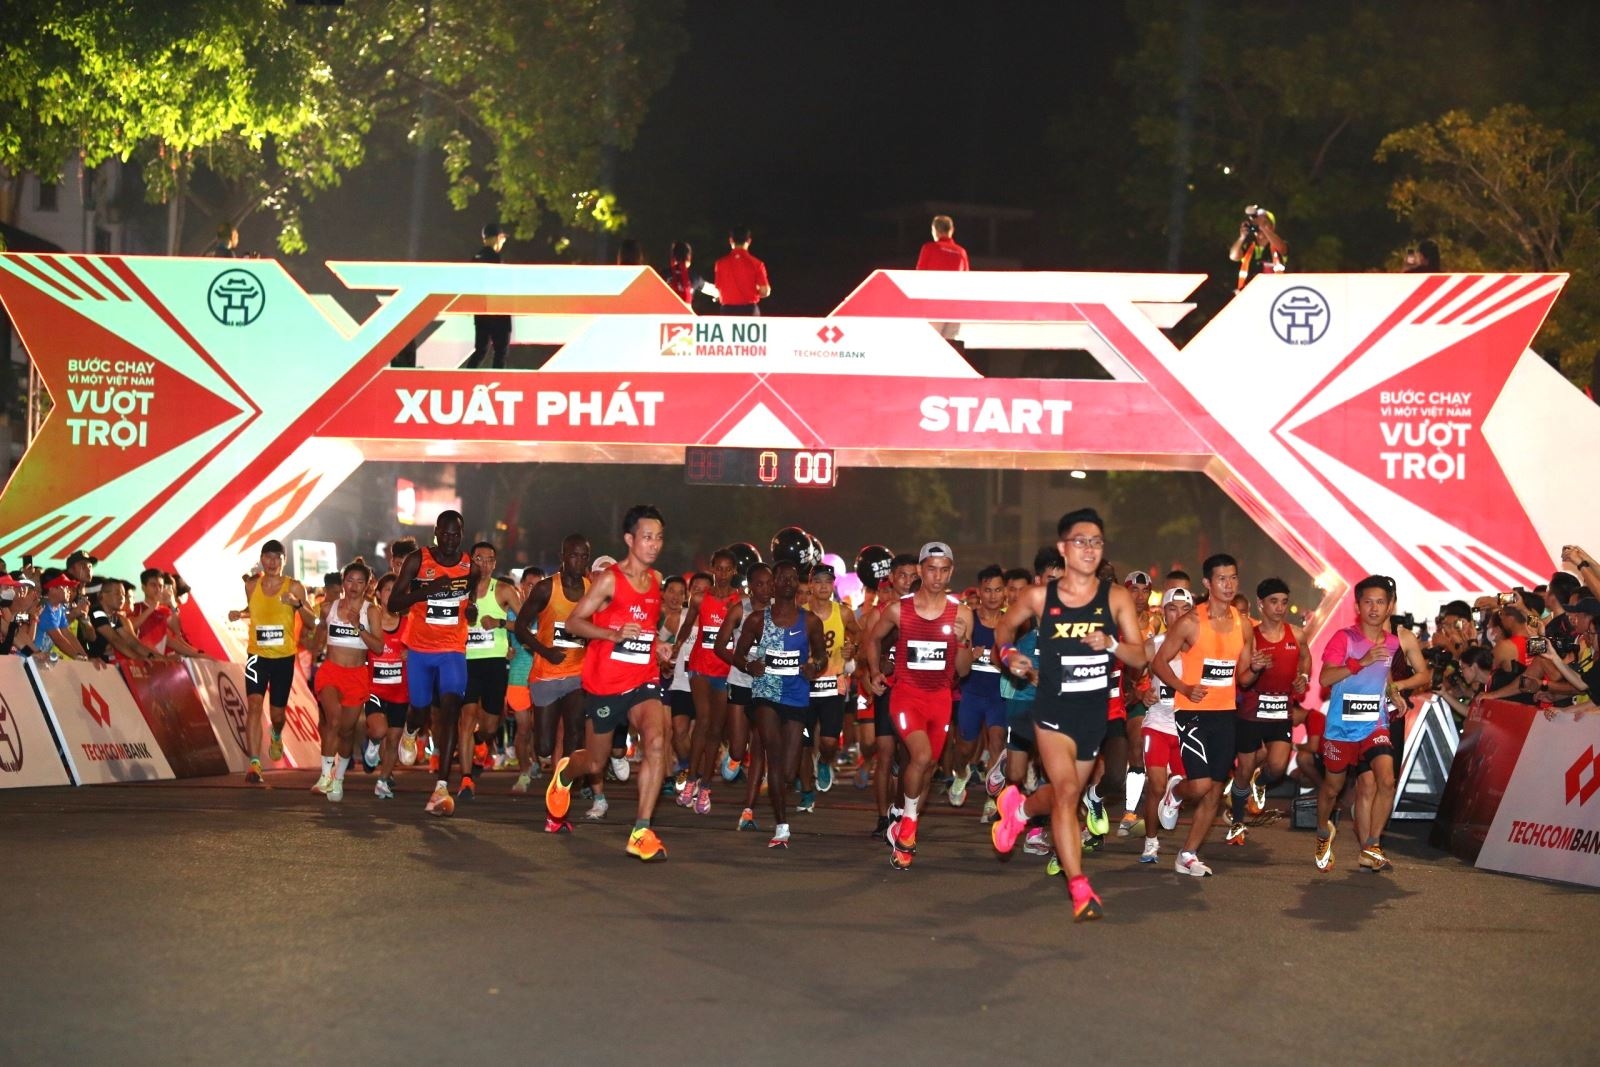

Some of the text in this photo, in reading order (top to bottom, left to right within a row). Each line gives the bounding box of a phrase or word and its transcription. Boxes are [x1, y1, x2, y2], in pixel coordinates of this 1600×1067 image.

[696, 323, 767, 343] HA NOI
[696, 345, 767, 356] MARATHON
[794, 349, 866, 359] TECHCOMBANK
[68, 357, 155, 376] BƯỚC CHẠY
[68, 373, 155, 387] VÌ MỘT VIỆT NAM
[67, 387, 155, 418] VƯỢT
[394, 381, 665, 426] XUẤT PHÁT
[1380, 388, 1471, 407] BƯỚC CHẠY
[919, 395, 1072, 436] START
[1380, 405, 1472, 418] VÌ MỘT VIỆT NAM
[1379, 419, 1472, 450] VƯỢT
[427, 607, 434, 615] A
[554, 629, 561, 637] A
[623, 641, 651, 651] 40295
[772, 658, 799, 666] 40084
[1350, 702, 1378, 711] 40704
[81, 743, 153, 761] TECHCOMBANK
[1507, 820, 1600, 855] TECHCOMBAN
